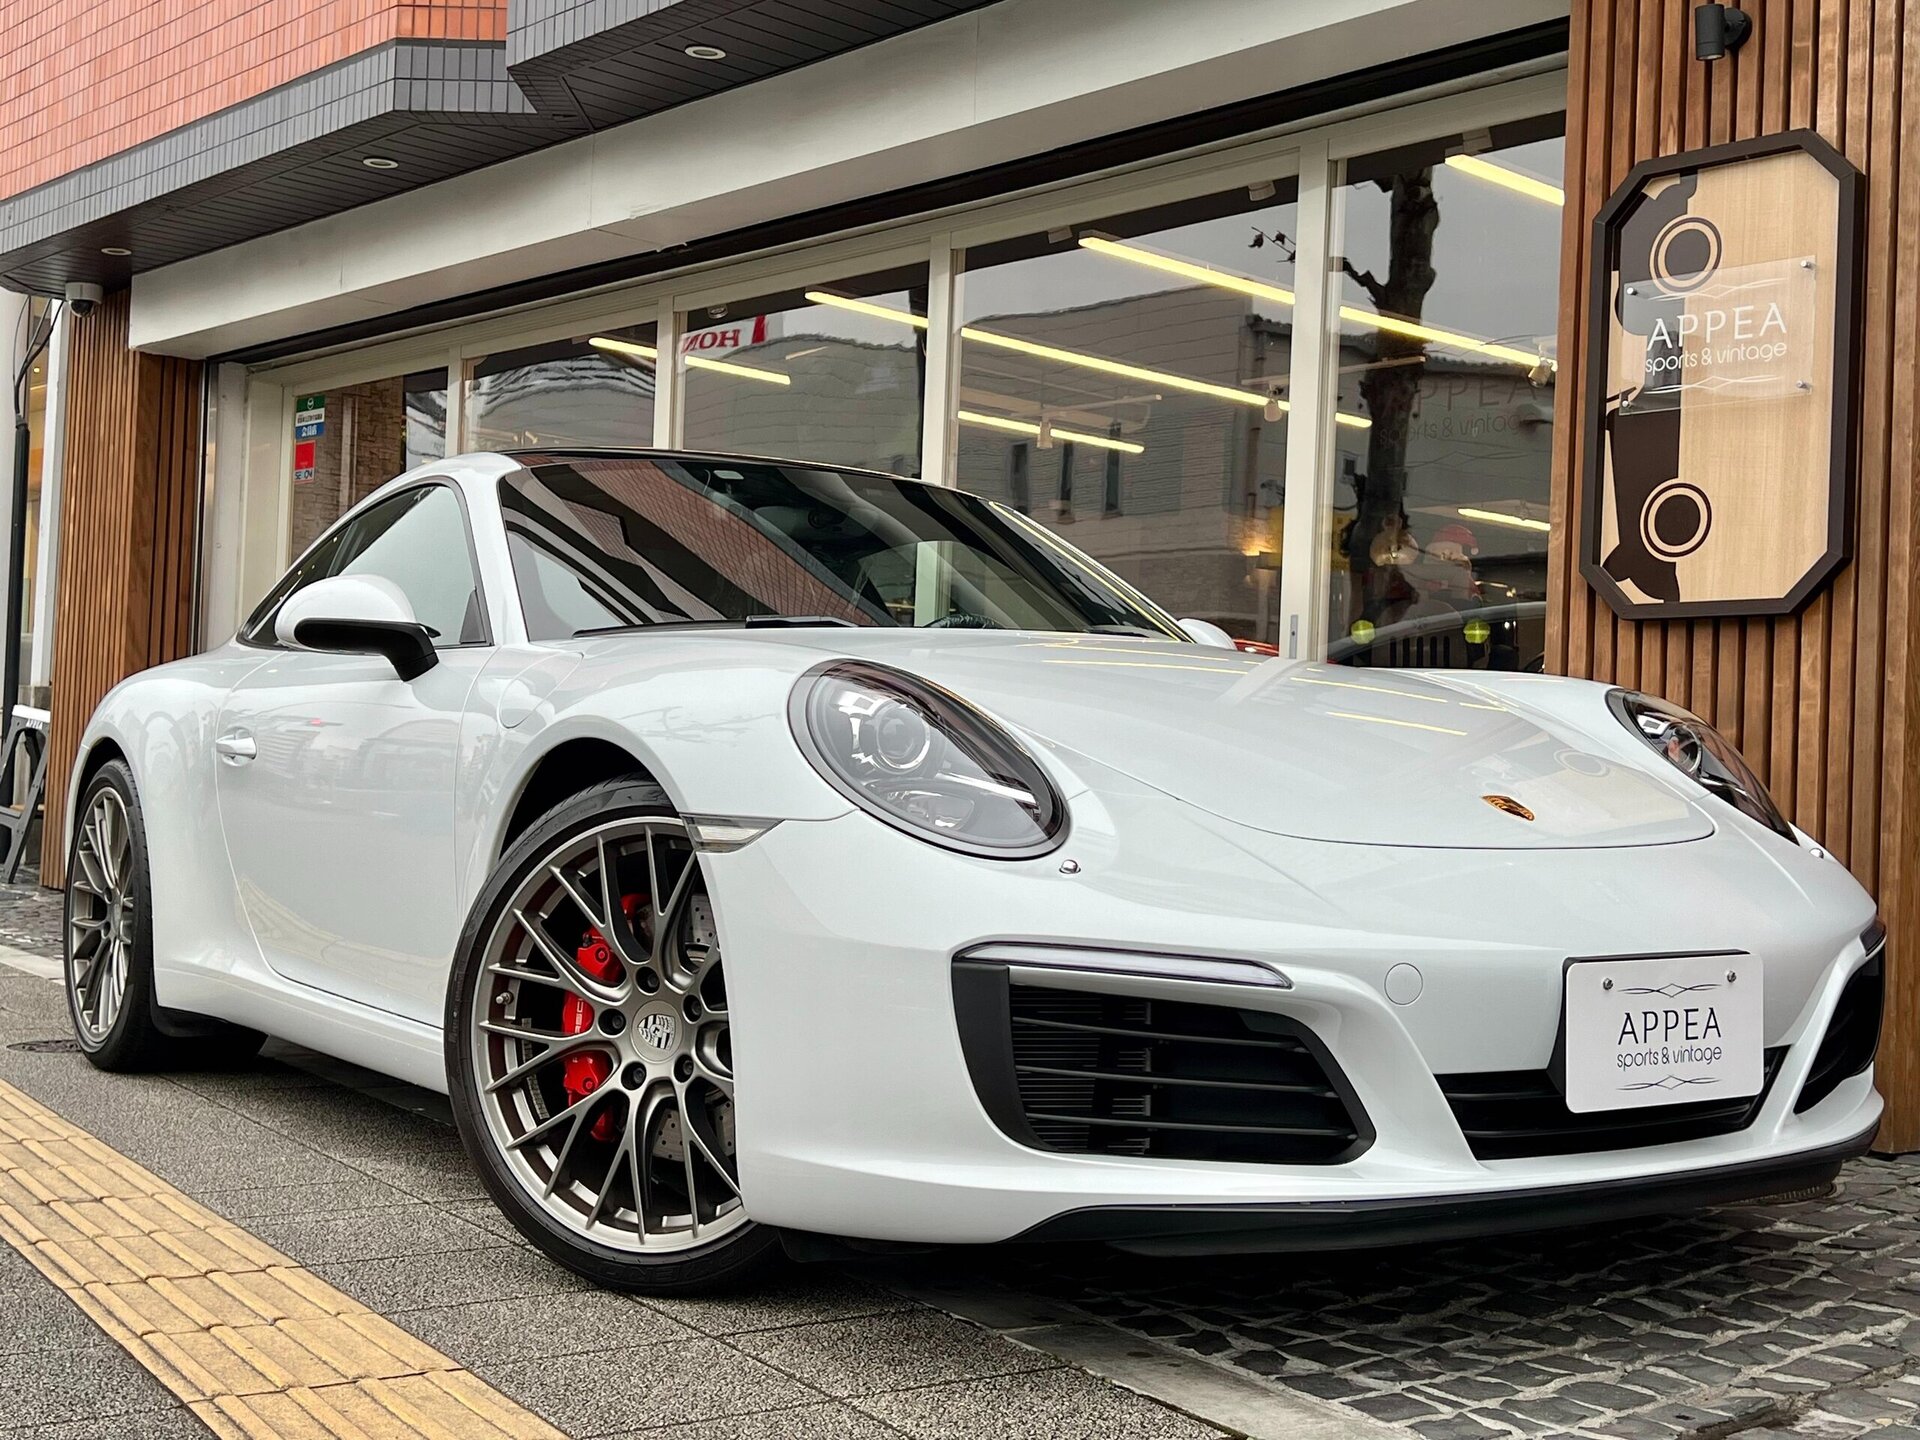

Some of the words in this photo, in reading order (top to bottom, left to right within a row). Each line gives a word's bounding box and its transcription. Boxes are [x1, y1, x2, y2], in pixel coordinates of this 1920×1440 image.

[1647, 302, 1787, 351] APPEA
[1645, 351, 1698, 376] sports
[1701, 347, 1712, 366] &
[1716, 342, 1788, 363] vintage
[1460, 411, 1538, 437] vintag
[1617, 1007, 1722, 1045] APPEA
[1617, 1048, 1659, 1072] sports
[1661, 1046, 1670, 1064] &
[1672, 1045, 1722, 1065] vintage
